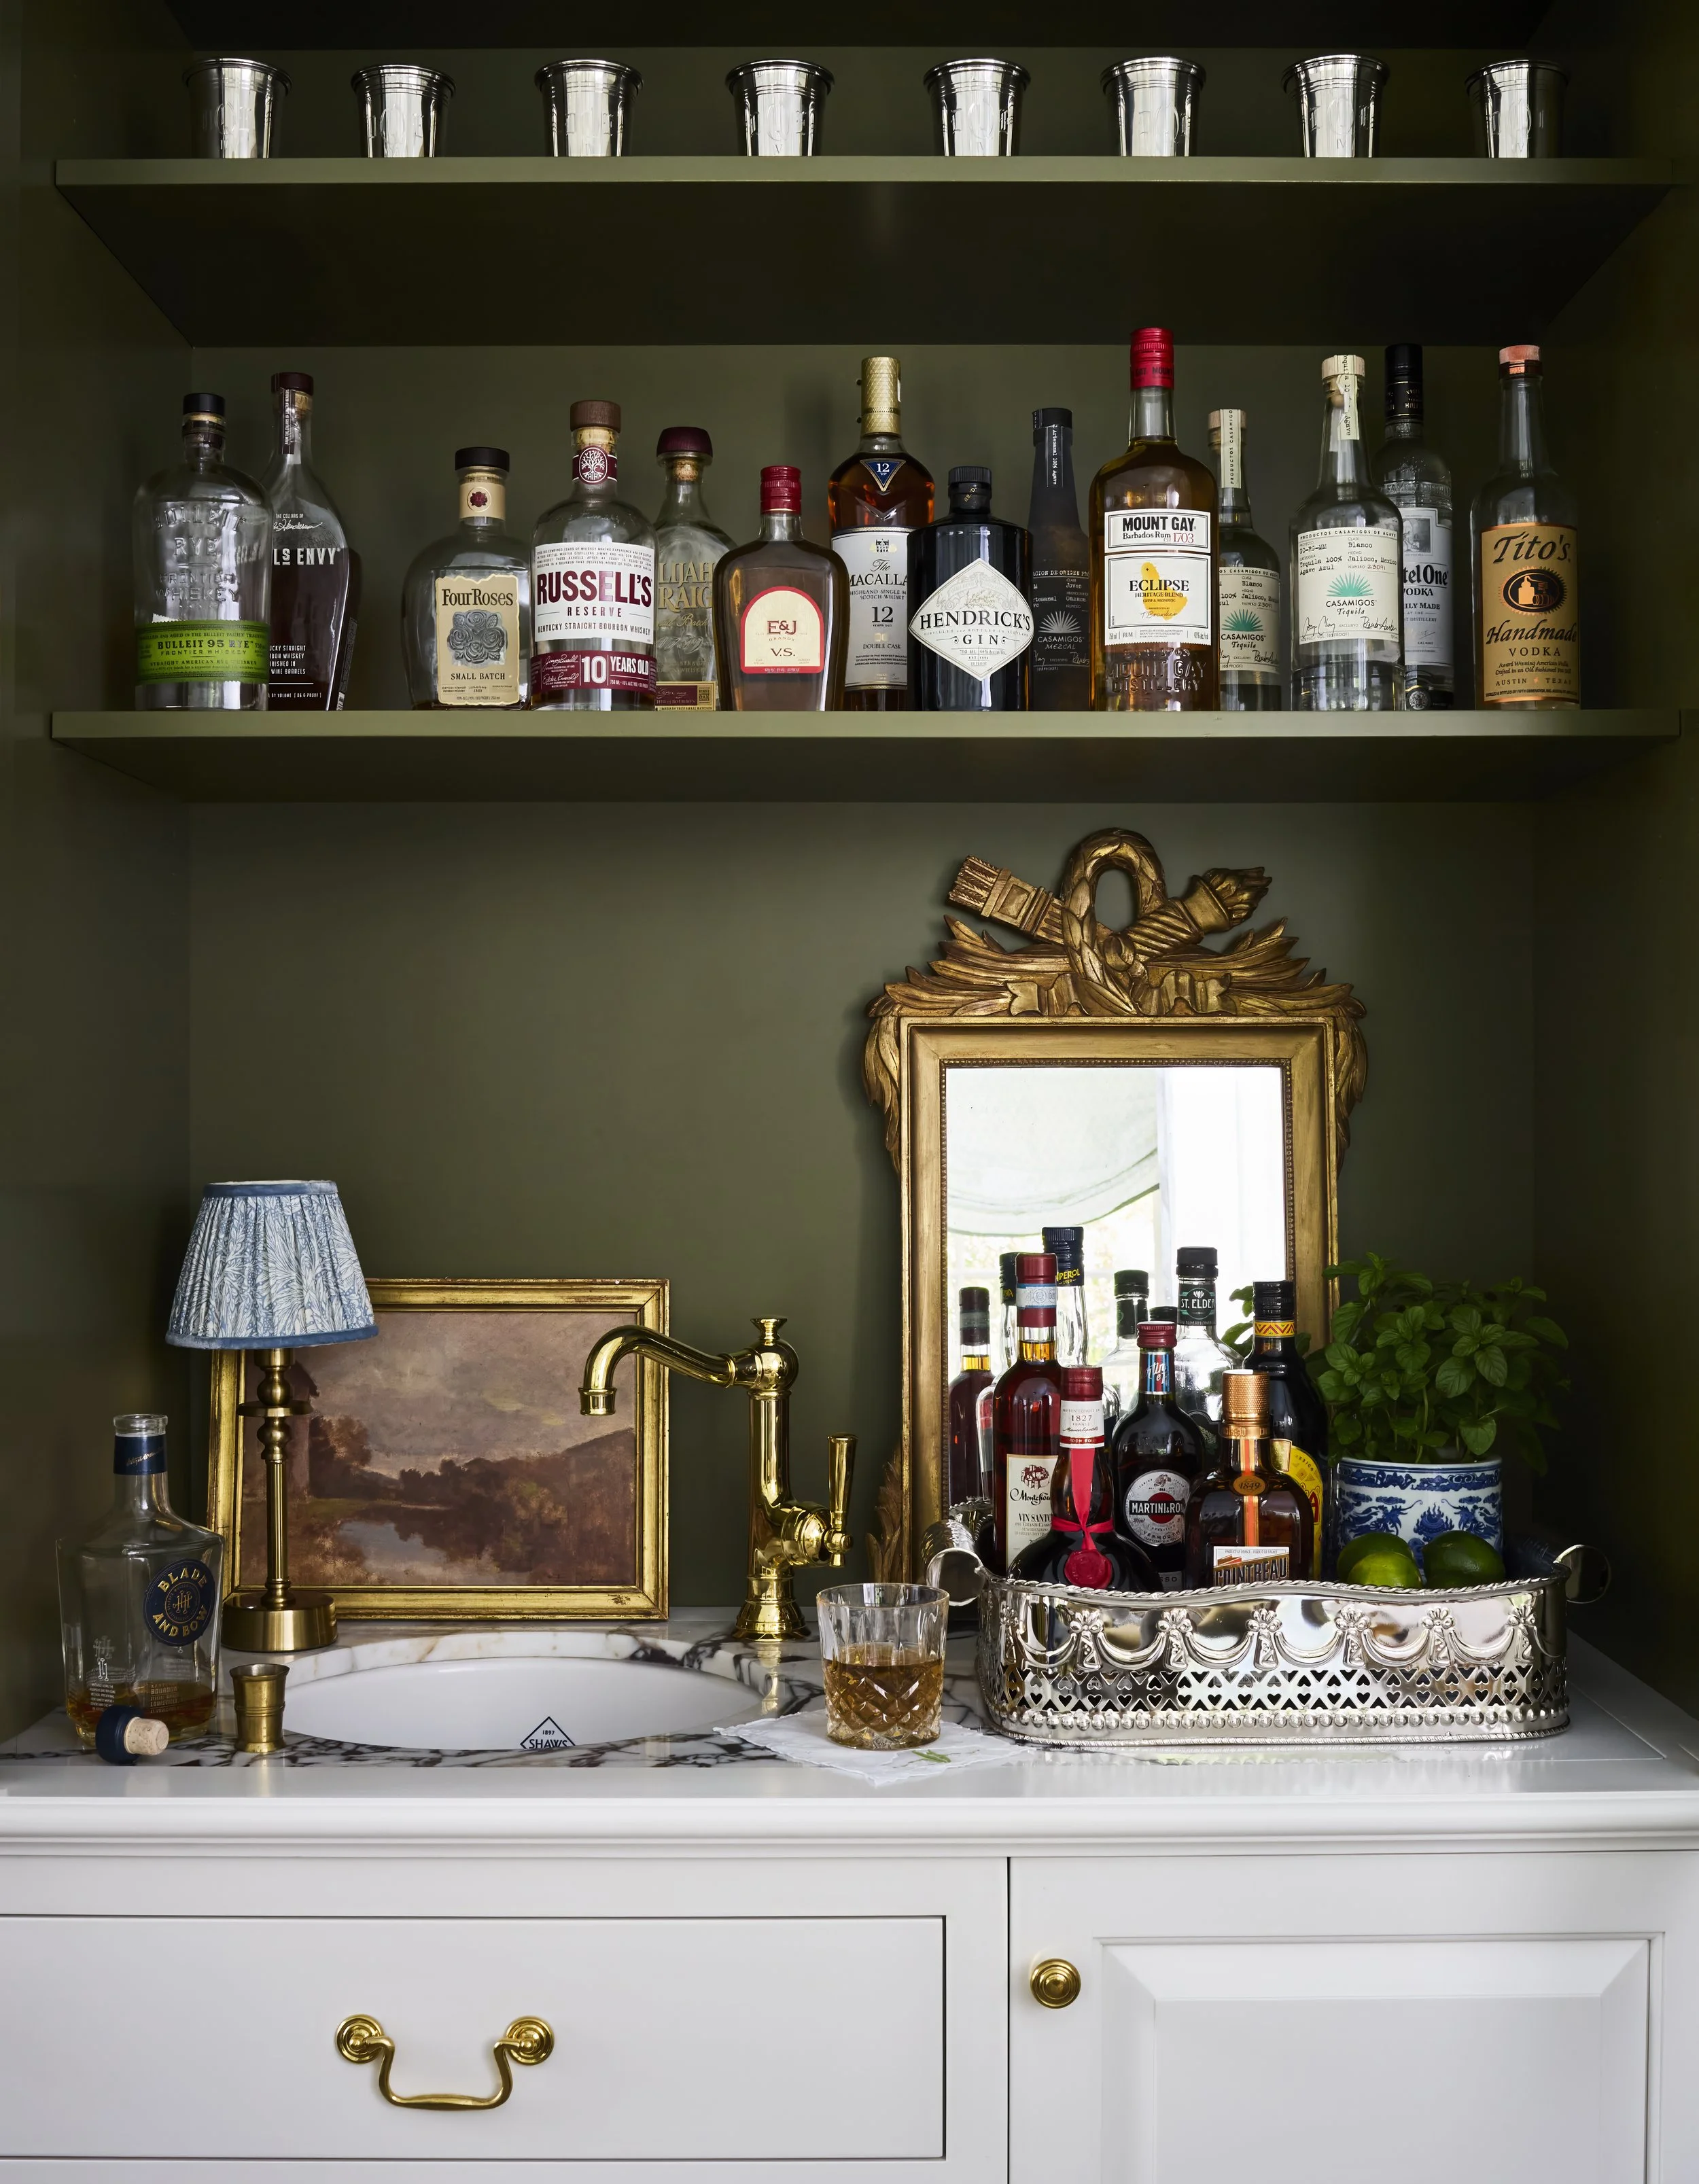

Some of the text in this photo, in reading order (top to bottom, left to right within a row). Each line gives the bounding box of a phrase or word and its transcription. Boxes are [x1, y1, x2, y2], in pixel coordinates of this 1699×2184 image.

[876, 463, 890, 473] 12
[1123, 516, 1195, 532] MOUNT GAY
[1123, 531, 1154, 540] Barbados
[1173, 532, 1195, 544] 1703
[1299, 531, 1331, 540] PRODUCTOS
[1492, 531, 1571, 564] Tito's
[296, 547, 336, 565] ENVY
[1380, 557, 1397, 565] Mexico
[870, 559, 891, 572] The
[1299, 559, 1322, 568] Tequila
[659, 561, 715, 586] LIJAH
[1299, 567, 1316, 576] Agave
[1403, 564, 1448, 586] tel One
[850, 574, 907, 586] MACALLA
[537, 569, 652, 607] RUSSELL'S
[1129, 580, 1189, 592] ECLIPSE
[442, 588, 514, 606] Four Roses
[658, 586, 714, 612] RAIG
[1326, 599, 1376, 607] CASAMIGOS
[567, 606, 622, 618] RESERVE
[871, 606, 894, 623] 12
[1337, 607, 1365, 617] Tequila
[919, 610, 1030, 631] HENDRICK'S
[538, 622, 651, 636] KENTUCKY STRAIGHT BOURBON WHISKEY
[767, 620, 796, 635] E&J
[1486, 618, 1577, 645] Handmade
[962, 634, 999, 645] GIN
[1037, 635, 1083, 644] CASAMIGOS
[1221, 633, 1265, 641] CASAMIGOS
[157, 639, 204, 650] BULLEIT
[207, 639, 224, 648] 95
[1231, 641, 1257, 650] Tequila
[771, 648, 796, 656] V.S.
[1508, 647, 1561, 656] VODKA
[581, 655, 607, 684] 10
[610, 656, 636, 673] YEARS
[637, 658, 649, 675] OLD
[1174, 659, 1207, 678] GAY
[1495, 668, 1511, 676] Crafted
[1495, 678, 1527, 686] AUSTIN
[1180, 1298, 1215, 1309] ST. ELDER
[1132, 1502, 1181, 1513] MARTINI&RO
[1018, 1513, 1030, 1522] VIN
[1143, 1530, 1180, 1540] VERMOUTH
[157, 1567, 207, 1592] BLADE
[152, 1604, 207, 1637] AND BOW
[529, 1738, 568, 1749] SHAWS
